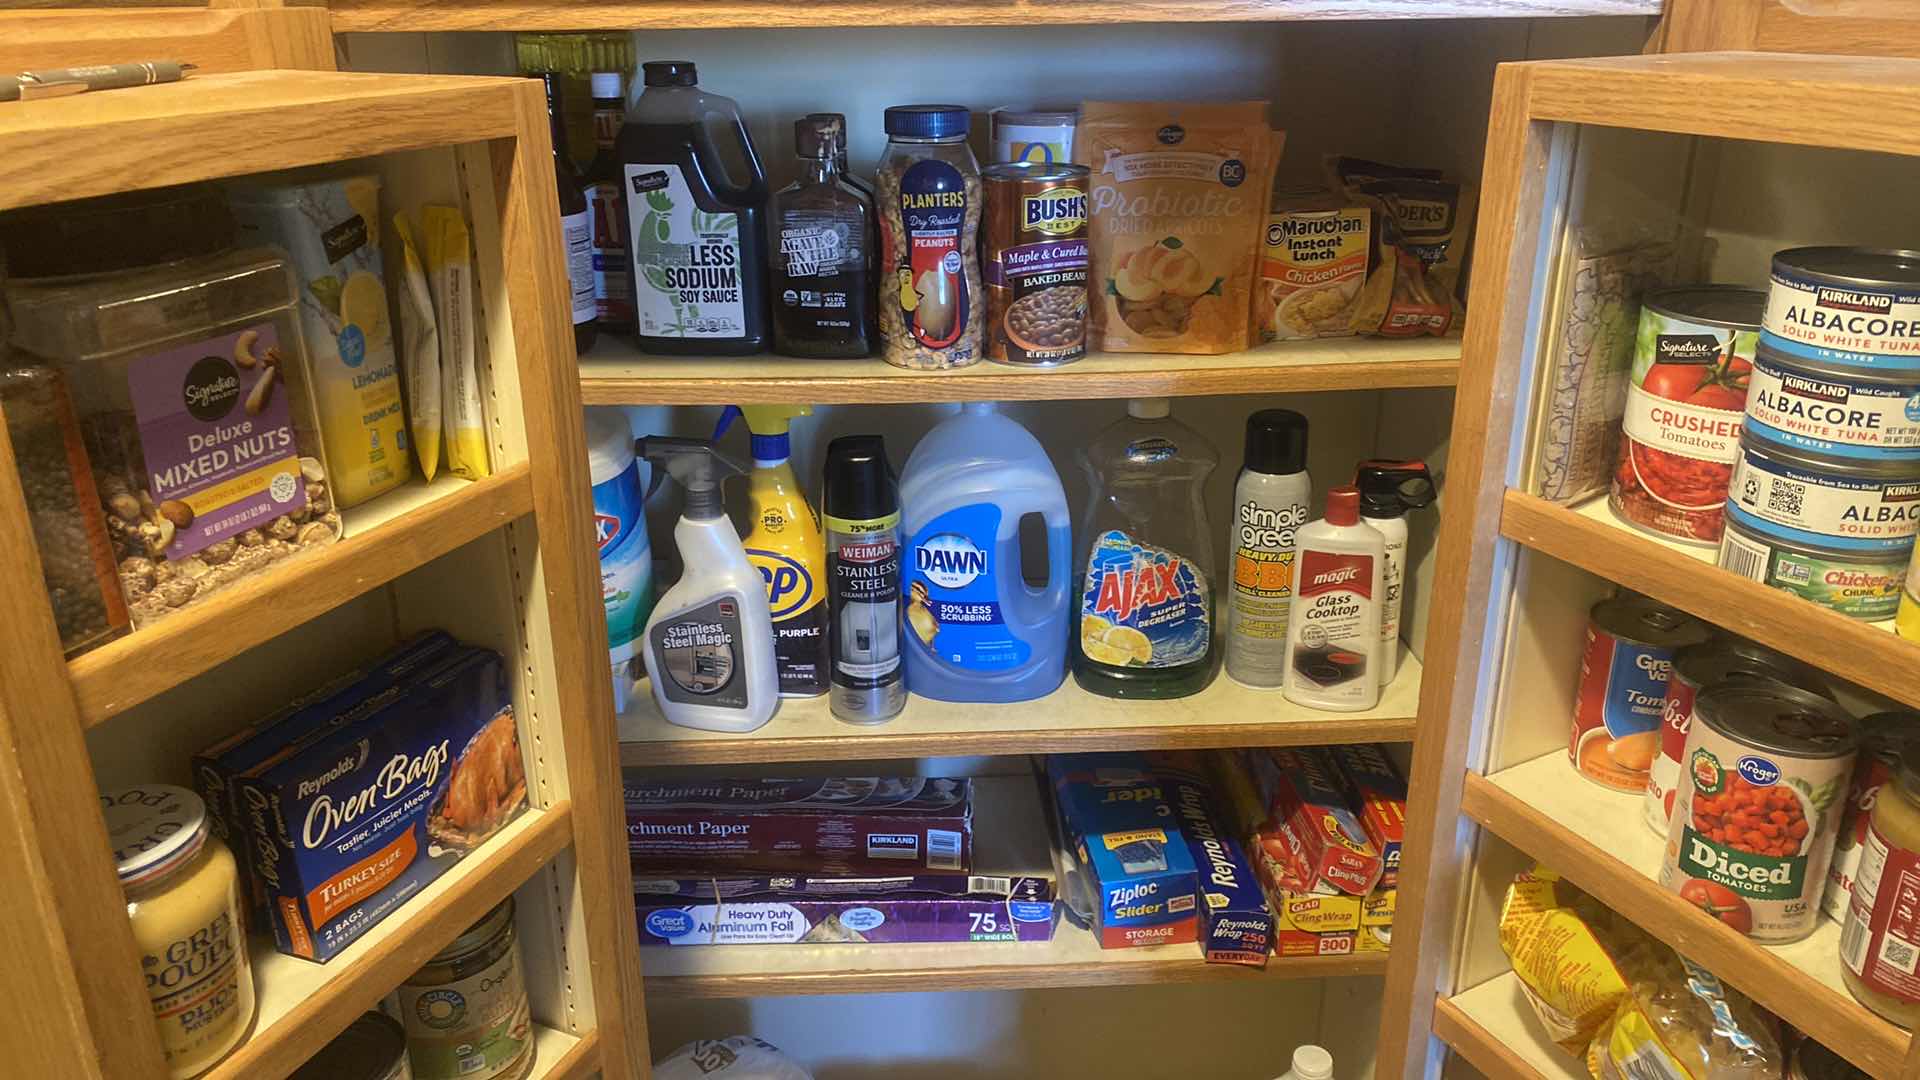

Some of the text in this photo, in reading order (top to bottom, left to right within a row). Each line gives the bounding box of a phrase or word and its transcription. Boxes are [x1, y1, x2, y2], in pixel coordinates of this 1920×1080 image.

[1223, 165, 1241, 178] BC
[903, 191, 964, 209] PLANTERS
[1091, 186, 1242, 217] Probiotic
[1027, 194, 1087, 224] BUSH'S
[910, 213, 960, 230] Dry Roasted
[1283, 217, 1362, 235] Maruchan
[781, 227, 822, 239] ORGANIC
[781, 237, 824, 253] AGAVE
[915, 239, 954, 248] PEANUTS
[1288, 235, 1342, 251] Instant
[690, 244, 735, 266] LESS
[788, 247, 840, 263] IN THE
[1008, 246, 1079, 265] Maple & Cured
[1293, 249, 1336, 262] Lunch
[665, 267, 737, 289] SODIUM
[787, 262, 820, 277] RAW
[1285, 266, 1339, 284] Chicken
[1023, 273, 1061, 287] BAKED
[680, 290, 739, 304] SOY SAUCE
[1820, 289, 1891, 308] KIRKLAND
[1785, 305, 1920, 337] ALBACORE
[1782, 325, 1920, 351] SOLID WHITE TUNA
[1660, 340, 1709, 358] Signature
[1834, 352, 1875, 363] WATER
[185, 376, 239, 407] Signature
[1784, 376, 1848, 398] KIRKLAND
[1874, 389, 1901, 398] Caught
[1757, 389, 1882, 429] ALBACORE
[1650, 407, 1742, 438] CRUSHED
[1755, 407, 1879, 442] SOLID WHITE TUNA
[189, 421, 253, 453] Deluxe
[1659, 426, 1727, 451] Tomatoes
[1781, 433, 1833, 449] IN WATER
[154, 427, 292, 493] MIXED NUTS
[1785, 471, 1817, 485] Traceable
[1819, 479, 1836, 487] from
[1837, 481, 1850, 489] Sea
[1886, 486, 1920, 497] KIRKL
[764, 516, 783, 524] PRO
[1240, 501, 1307, 531] simple
[1841, 504, 1920, 523] ALBAC
[1839, 524, 1882, 534] SOLID
[843, 543, 891, 559] WEIMAN
[837, 560, 897, 578] STAINLESS
[916, 546, 987, 576] DAWN
[851, 577, 888, 590] STEEL
[1313, 568, 1360, 585] magic
[1825, 570, 1889, 588] Chicken
[1095, 559, 1181, 621] AJAX
[1843, 589, 1875, 597] CHUNK
[940, 604, 992, 614] 50% LESS
[1316, 595, 1352, 608] Glass
[940, 613, 992, 622] SCRUBBING
[1138, 608, 1187, 628] DEGREASER
[1150, 603, 1186, 618] SUPER
[1306, 604, 1360, 620] Cooktop
[667, 623, 723, 638] Stainless
[779, 628, 820, 638] PURPLE
[663, 632, 732, 649] Steel Magic
[1636, 654, 1672, 672] Gre
[297, 755, 355, 800] Reynolds
[1740, 760, 1777, 781] Kroger
[303, 784, 377, 849] Oven
[377, 737, 450, 800] Bags
[729, 786, 790, 800] Paper
[372, 809, 402, 832] Juicier
[404, 790, 432, 811] Meals.
[699, 822, 751, 837] Paper
[871, 837, 915, 845] KIRKLAND
[1191, 819, 1240, 889] Reynolds
[1689, 838, 1792, 885] Diced
[319, 863, 378, 905] TURKEY
[379, 847, 401, 871] SIZE
[1706, 870, 1768, 893] TOMATOES
[1110, 883, 1158, 907] Ziploc
[1115, 904, 1161, 919] Slider
[1291, 901, 1319, 912] GLAD
[1784, 903, 1808, 913] USA
[653, 917, 685, 926] Great
[728, 910, 793, 921] Heavy Duty
[969, 913, 997, 932] 75
[325, 908, 364, 941] 2 BAGS
[698, 921, 794, 933] Aluminum Foil
[1218, 918, 1268, 931] Reynolds
[1125, 928, 1174, 940] STORAGE
[1213, 928, 1266, 944] Wrap 250
[1320, 939, 1349, 951] 300
[1214, 952, 1260, 961] EVERYDAY
